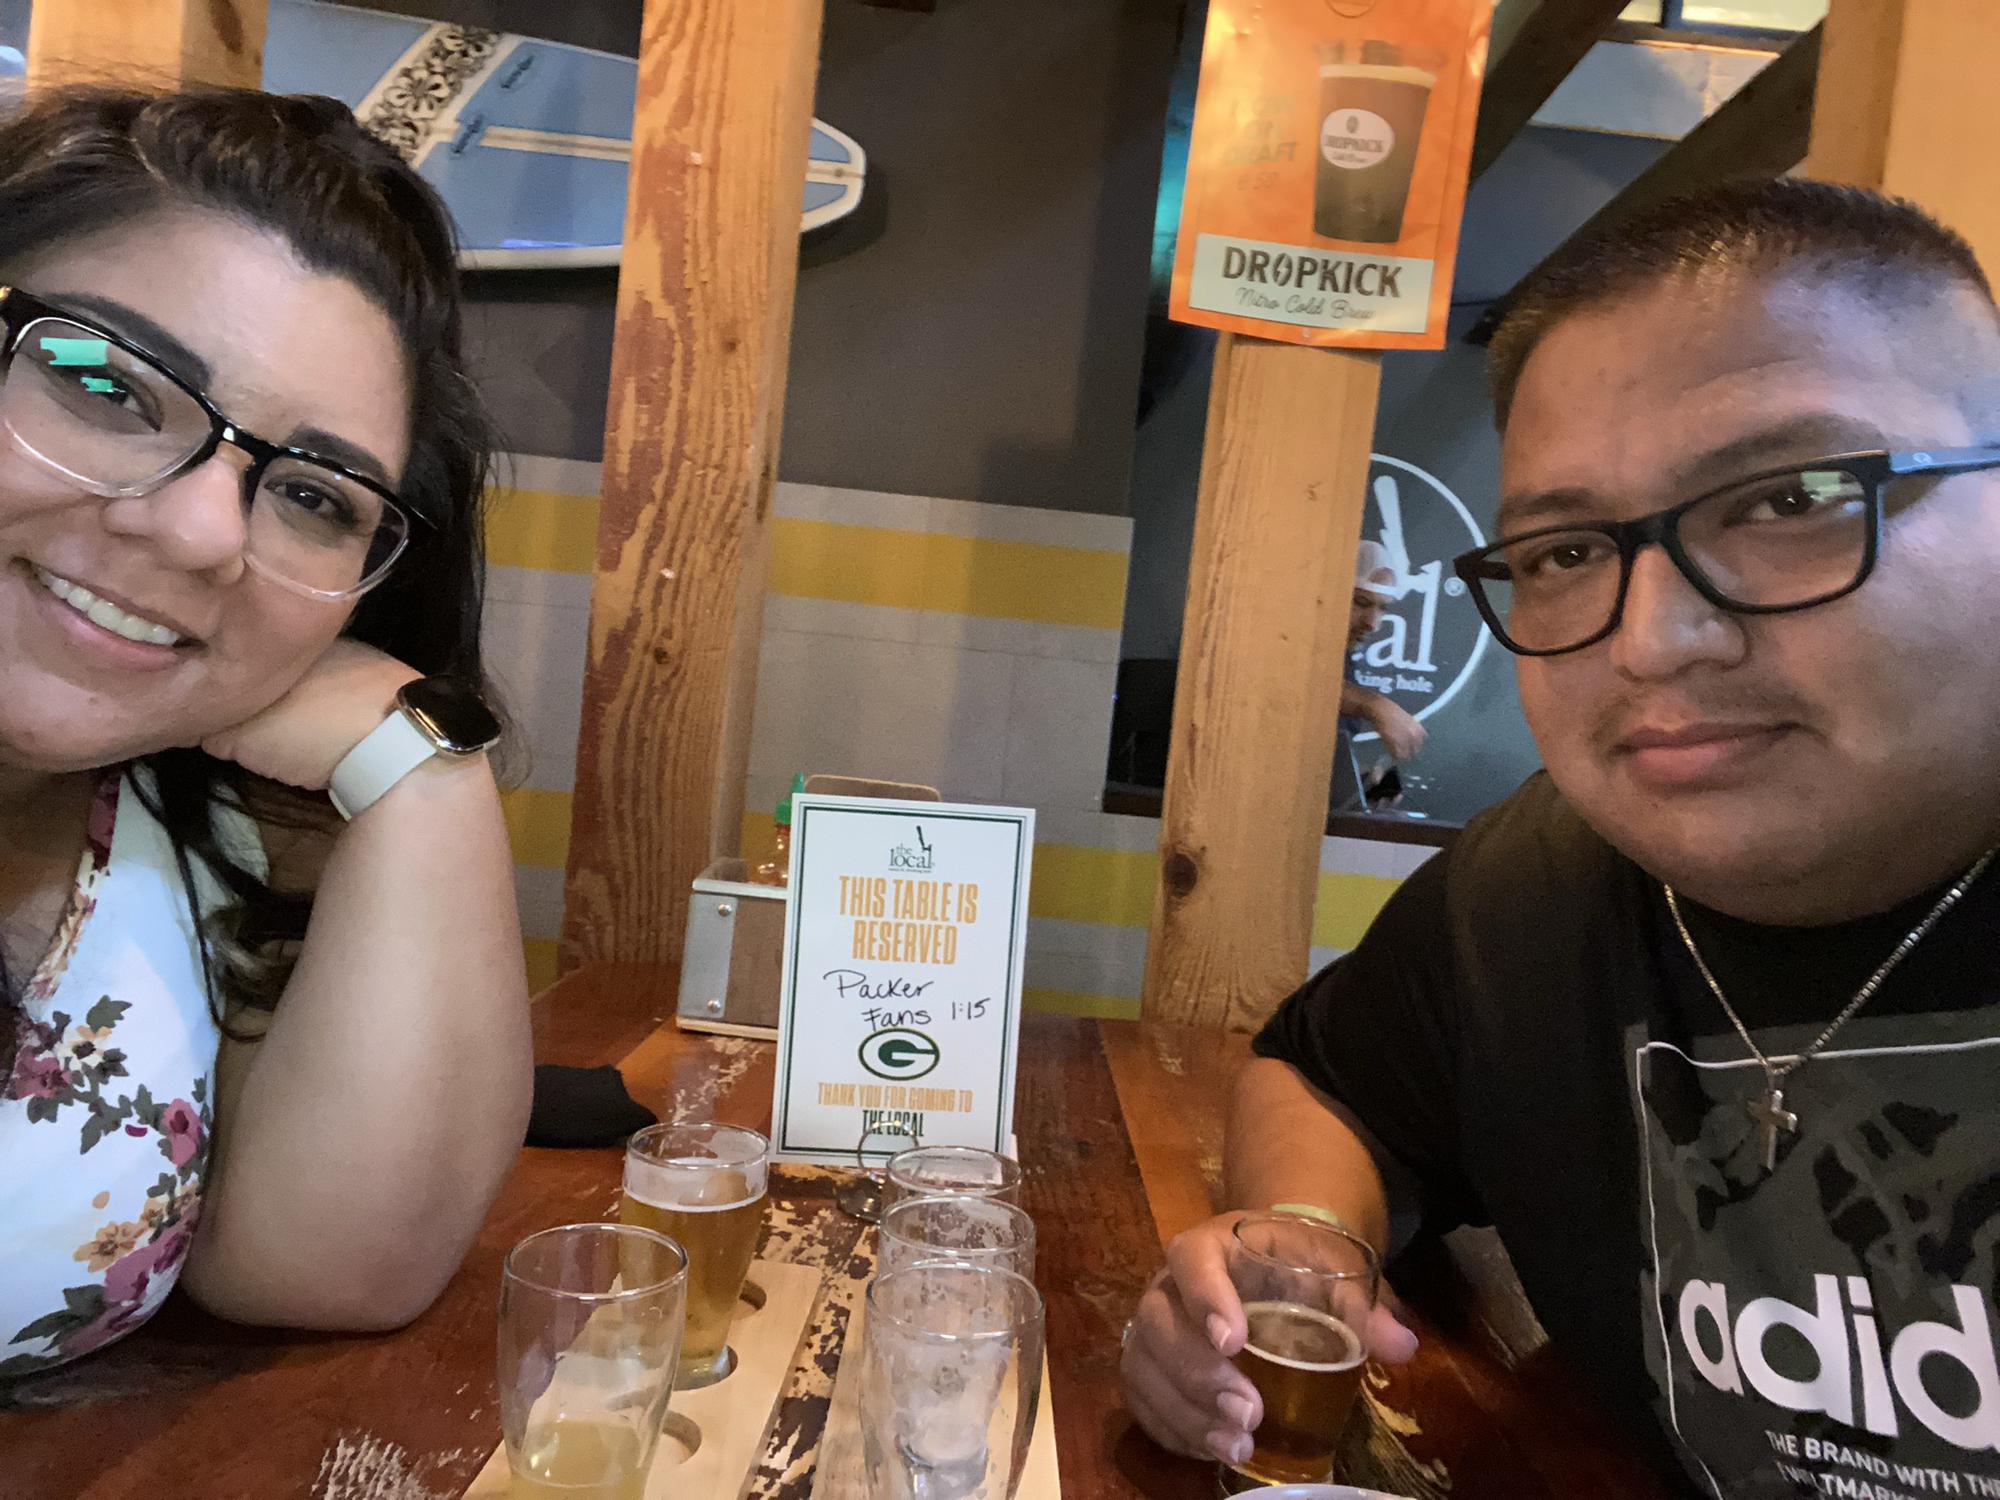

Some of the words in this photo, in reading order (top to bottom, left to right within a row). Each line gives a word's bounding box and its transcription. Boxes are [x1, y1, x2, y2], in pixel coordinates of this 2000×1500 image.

[1222, 245, 1402, 298] DROPKICK
[1236, 287, 1280, 311] Nitro
[1284, 294, 1324, 315] Cold
[1330, 299, 1376, 319] Brew
[889, 844, 932, 869] local
[838, 875, 887, 919] THIS
[892, 879, 953, 922] TABLE
[956, 883, 979, 924] IS
[851, 920, 959, 965] RESERVED
[823, 969, 935, 999] Packer
[861, 1007, 932, 1032] Fans
[951, 998, 991, 1021] 1:15
[818, 1082, 855, 1107] THANK
[857, 1084, 882, 1108] YOU
[884, 1085, 907, 1109] FOR
[909, 1087, 956, 1112] COMING
[958, 1089, 974, 1113] TO
[862, 1109, 884, 1135] THE
[887, 1111, 924, 1137] LOCAL
[1764, 1430, 1800, 1457] THE
[1804, 1436, 1890, 1479] BRAND
[1893, 1463, 1962, 1495] WITH
